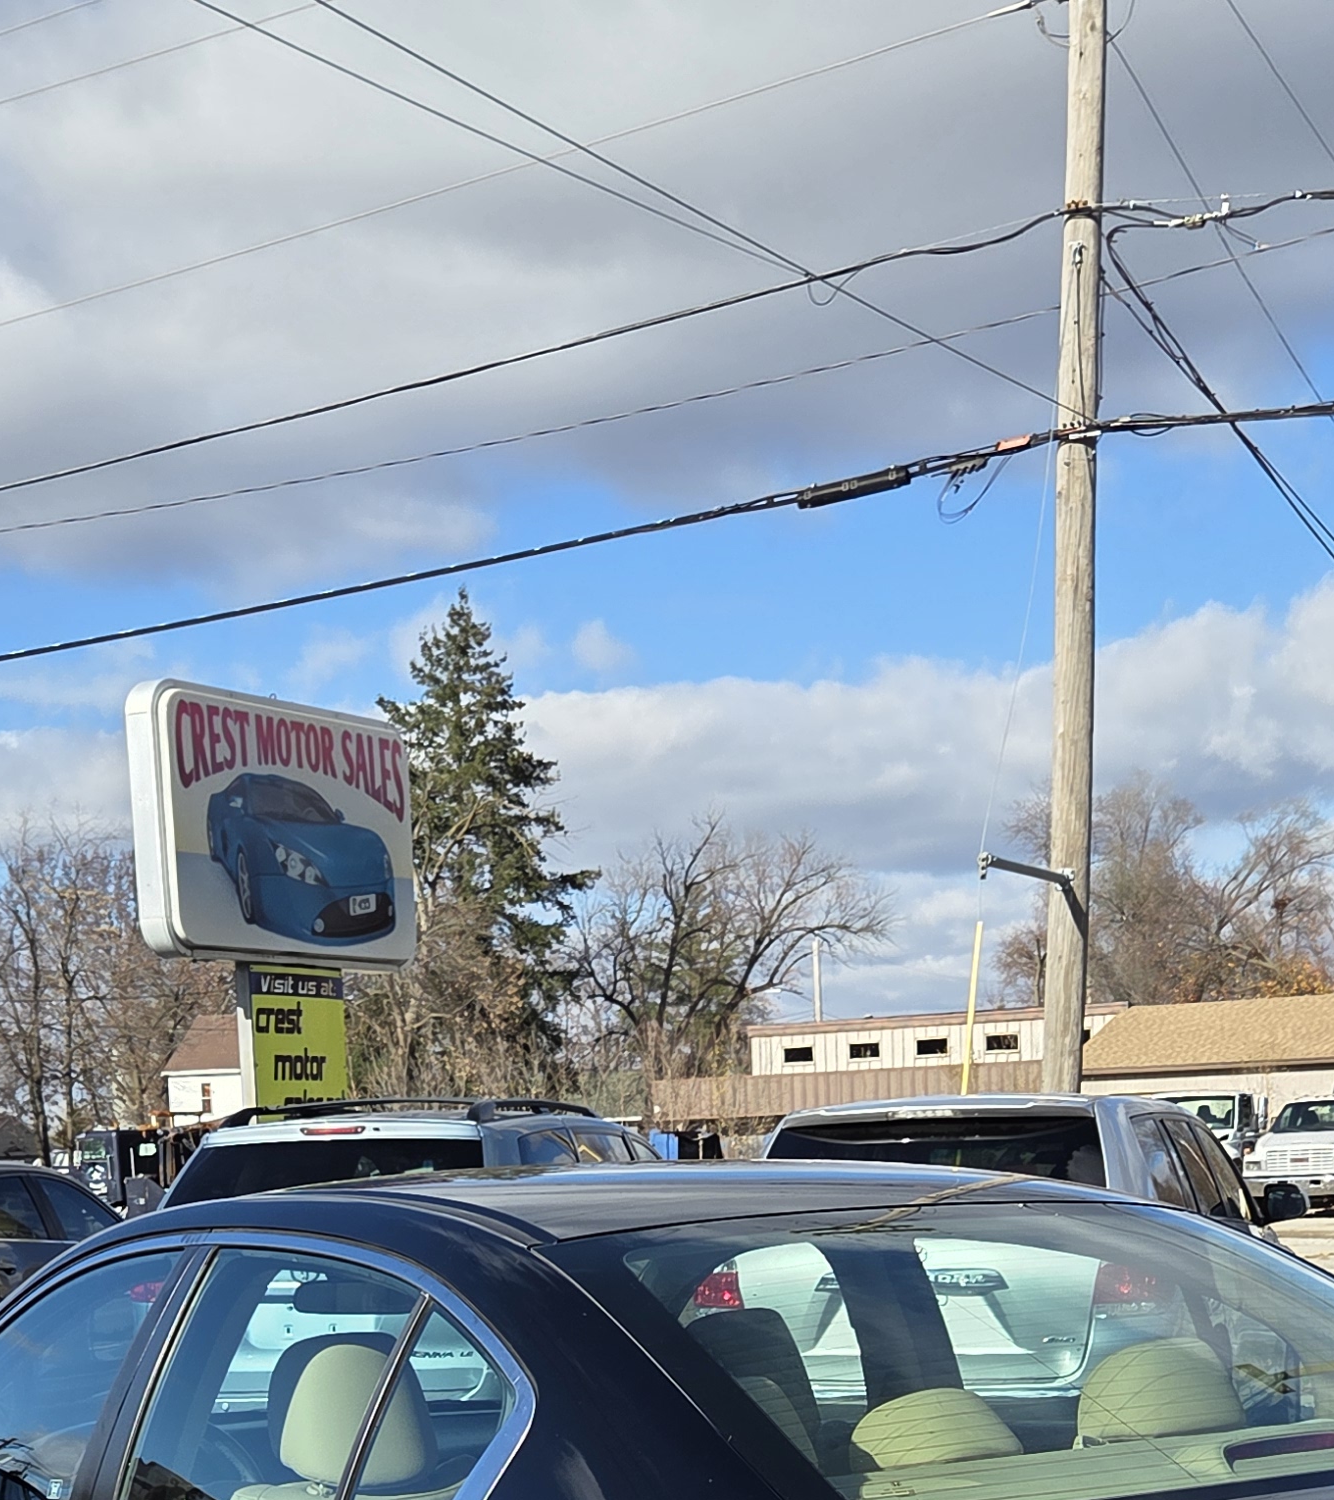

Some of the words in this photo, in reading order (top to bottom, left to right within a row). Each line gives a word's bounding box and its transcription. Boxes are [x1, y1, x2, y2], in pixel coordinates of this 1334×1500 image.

[175, 699, 250, 789] CREST
[255, 713, 338, 779] MOTOR
[342, 729, 405, 823] SALES
[261, 975, 294, 994] Visit
[298, 981, 317, 995] us
[320, 979, 337, 996] at:
[255, 1001, 302, 1034] crest
[273, 1047, 326, 1081] motor
